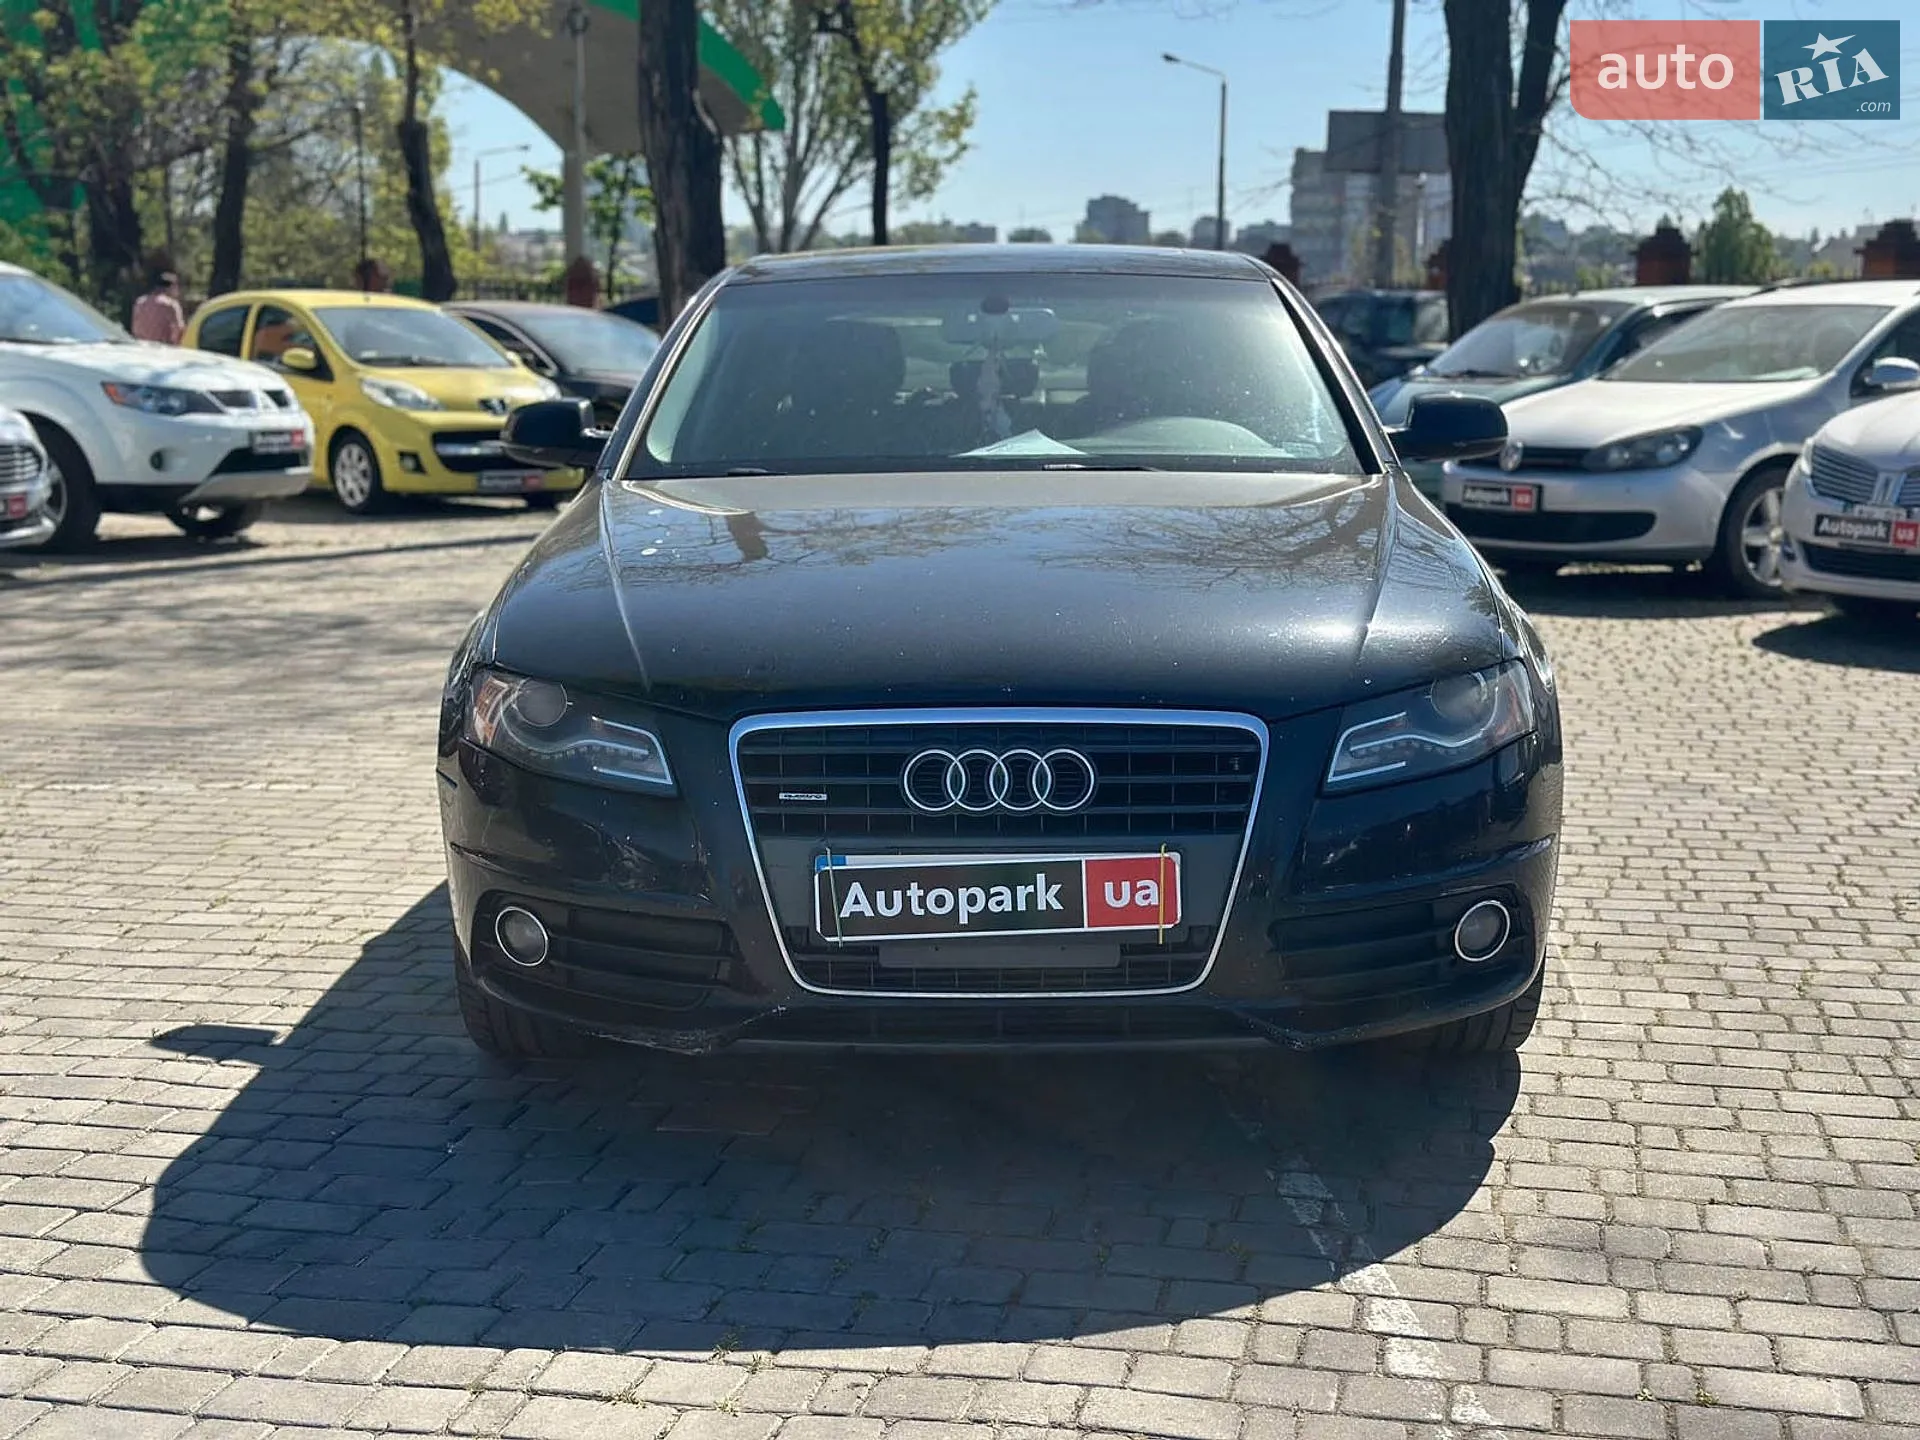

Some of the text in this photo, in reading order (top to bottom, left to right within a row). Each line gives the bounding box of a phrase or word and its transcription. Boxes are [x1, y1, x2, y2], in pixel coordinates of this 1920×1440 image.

[1819, 517, 1887, 540] Autopark
[840, 874, 1159, 924] Autopark ua
